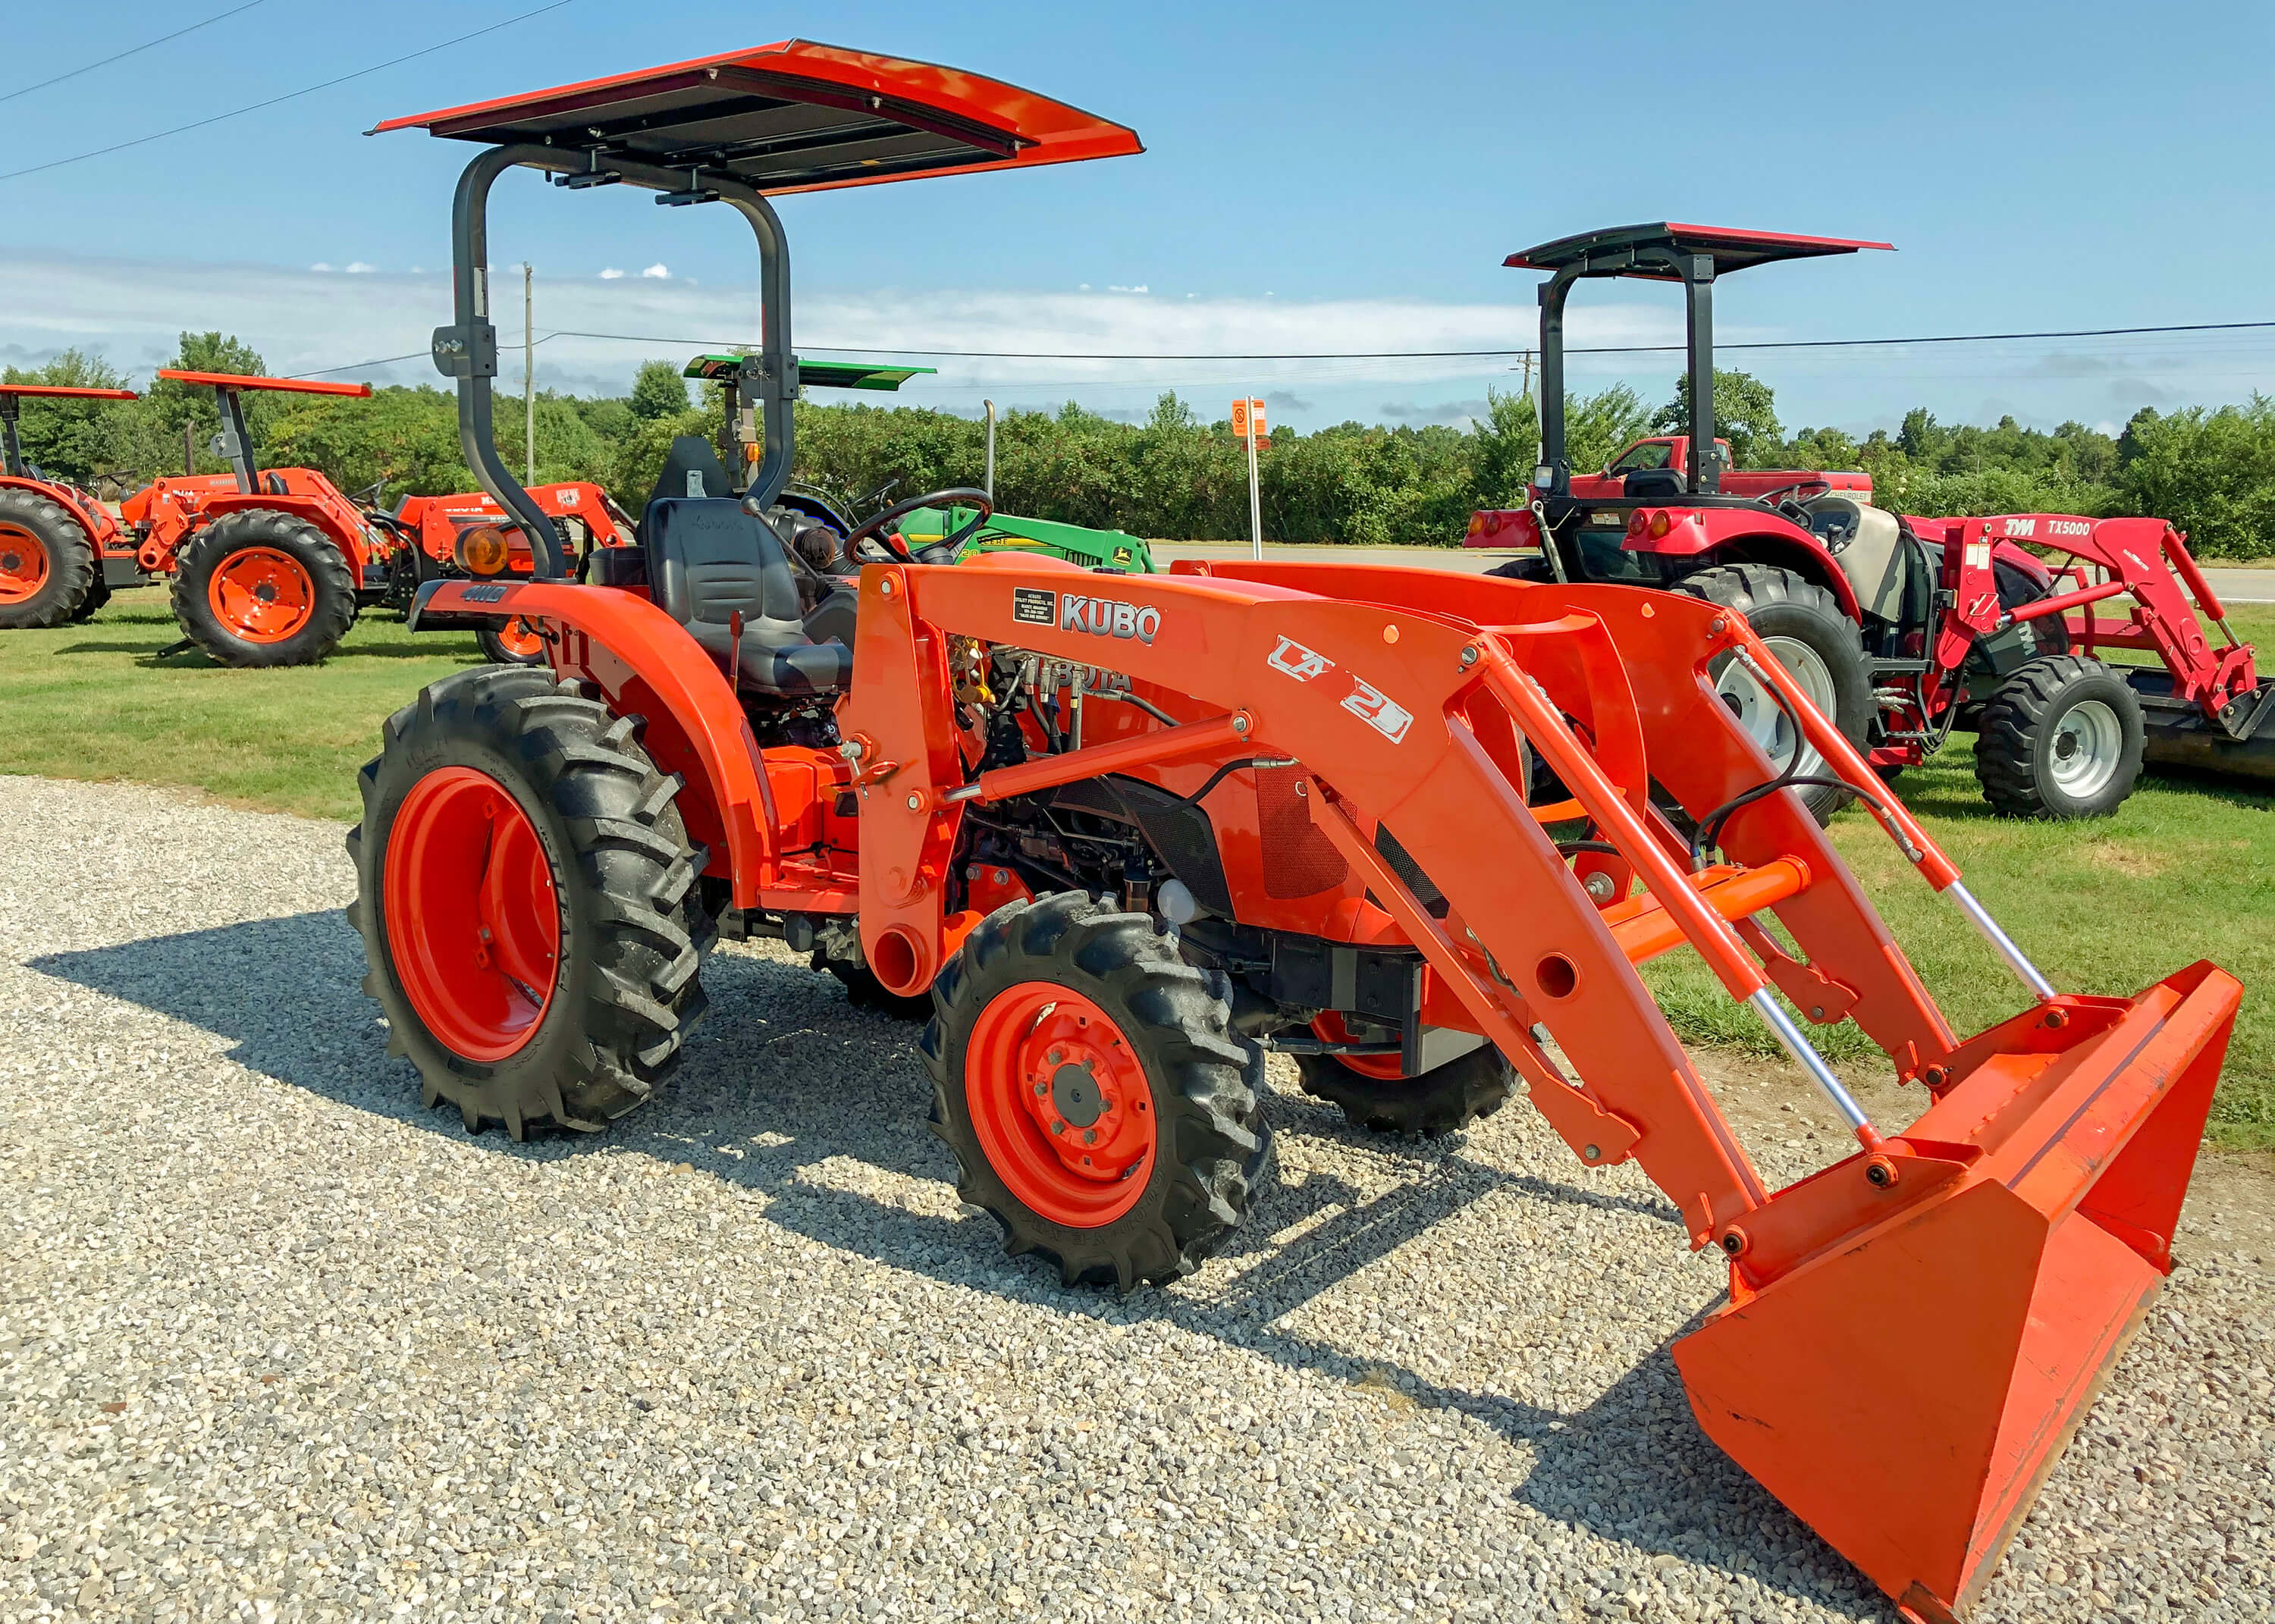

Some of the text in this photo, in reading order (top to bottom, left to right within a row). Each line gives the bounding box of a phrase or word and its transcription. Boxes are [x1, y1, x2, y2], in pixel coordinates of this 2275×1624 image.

[2004, 519, 2091, 536] TYM TX5000
[461, 585, 508, 603] 4WD
